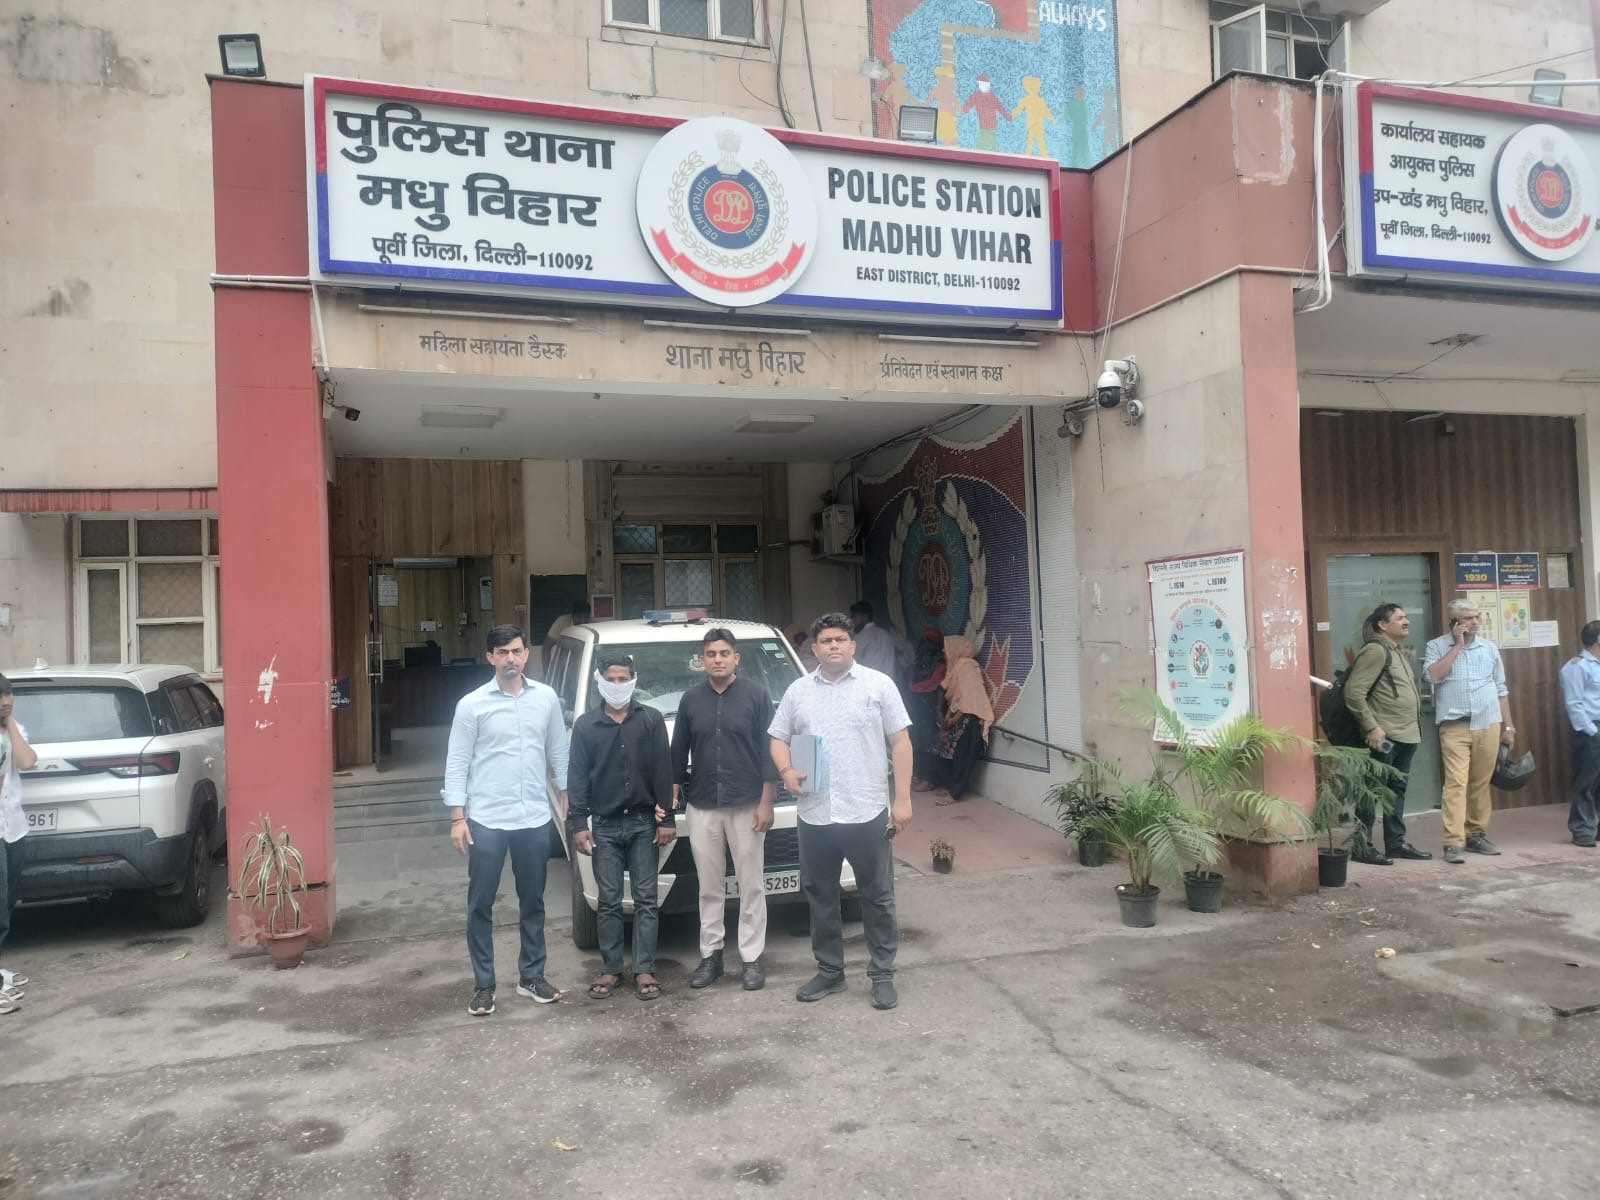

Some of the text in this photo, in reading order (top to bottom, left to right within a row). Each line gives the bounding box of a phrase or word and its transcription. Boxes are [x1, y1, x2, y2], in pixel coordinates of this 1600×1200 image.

[1039, 2, 1107, 31] ALWAYS
[333, 102, 616, 170] पुलिस थाना
[1380, 121, 1486, 149] कार्यालय सहायक
[1389, 153, 1475, 181] आयुक्त पुलिस
[357, 172, 602, 232] मधु विहार
[828, 166, 1042, 218] POLICE STATION
[1426, 194, 1448, 217] मधु
[1451, 191, 1488, 215] विहार,
[372, 232, 594, 271] पूर्वी जिला, दिल्ली-110092
[842, 218, 1032, 264] MADHU VIHAR
[856, 266, 1020, 291] EAST DISTRICT, DELHI-110092
[418, 331, 467, 359] महिला
[469, 335, 525, 358] सहायता
[757, 341, 806, 377] विहार
[25, 812, 56, 828] 961
[763, 875, 798, 891] 5285
